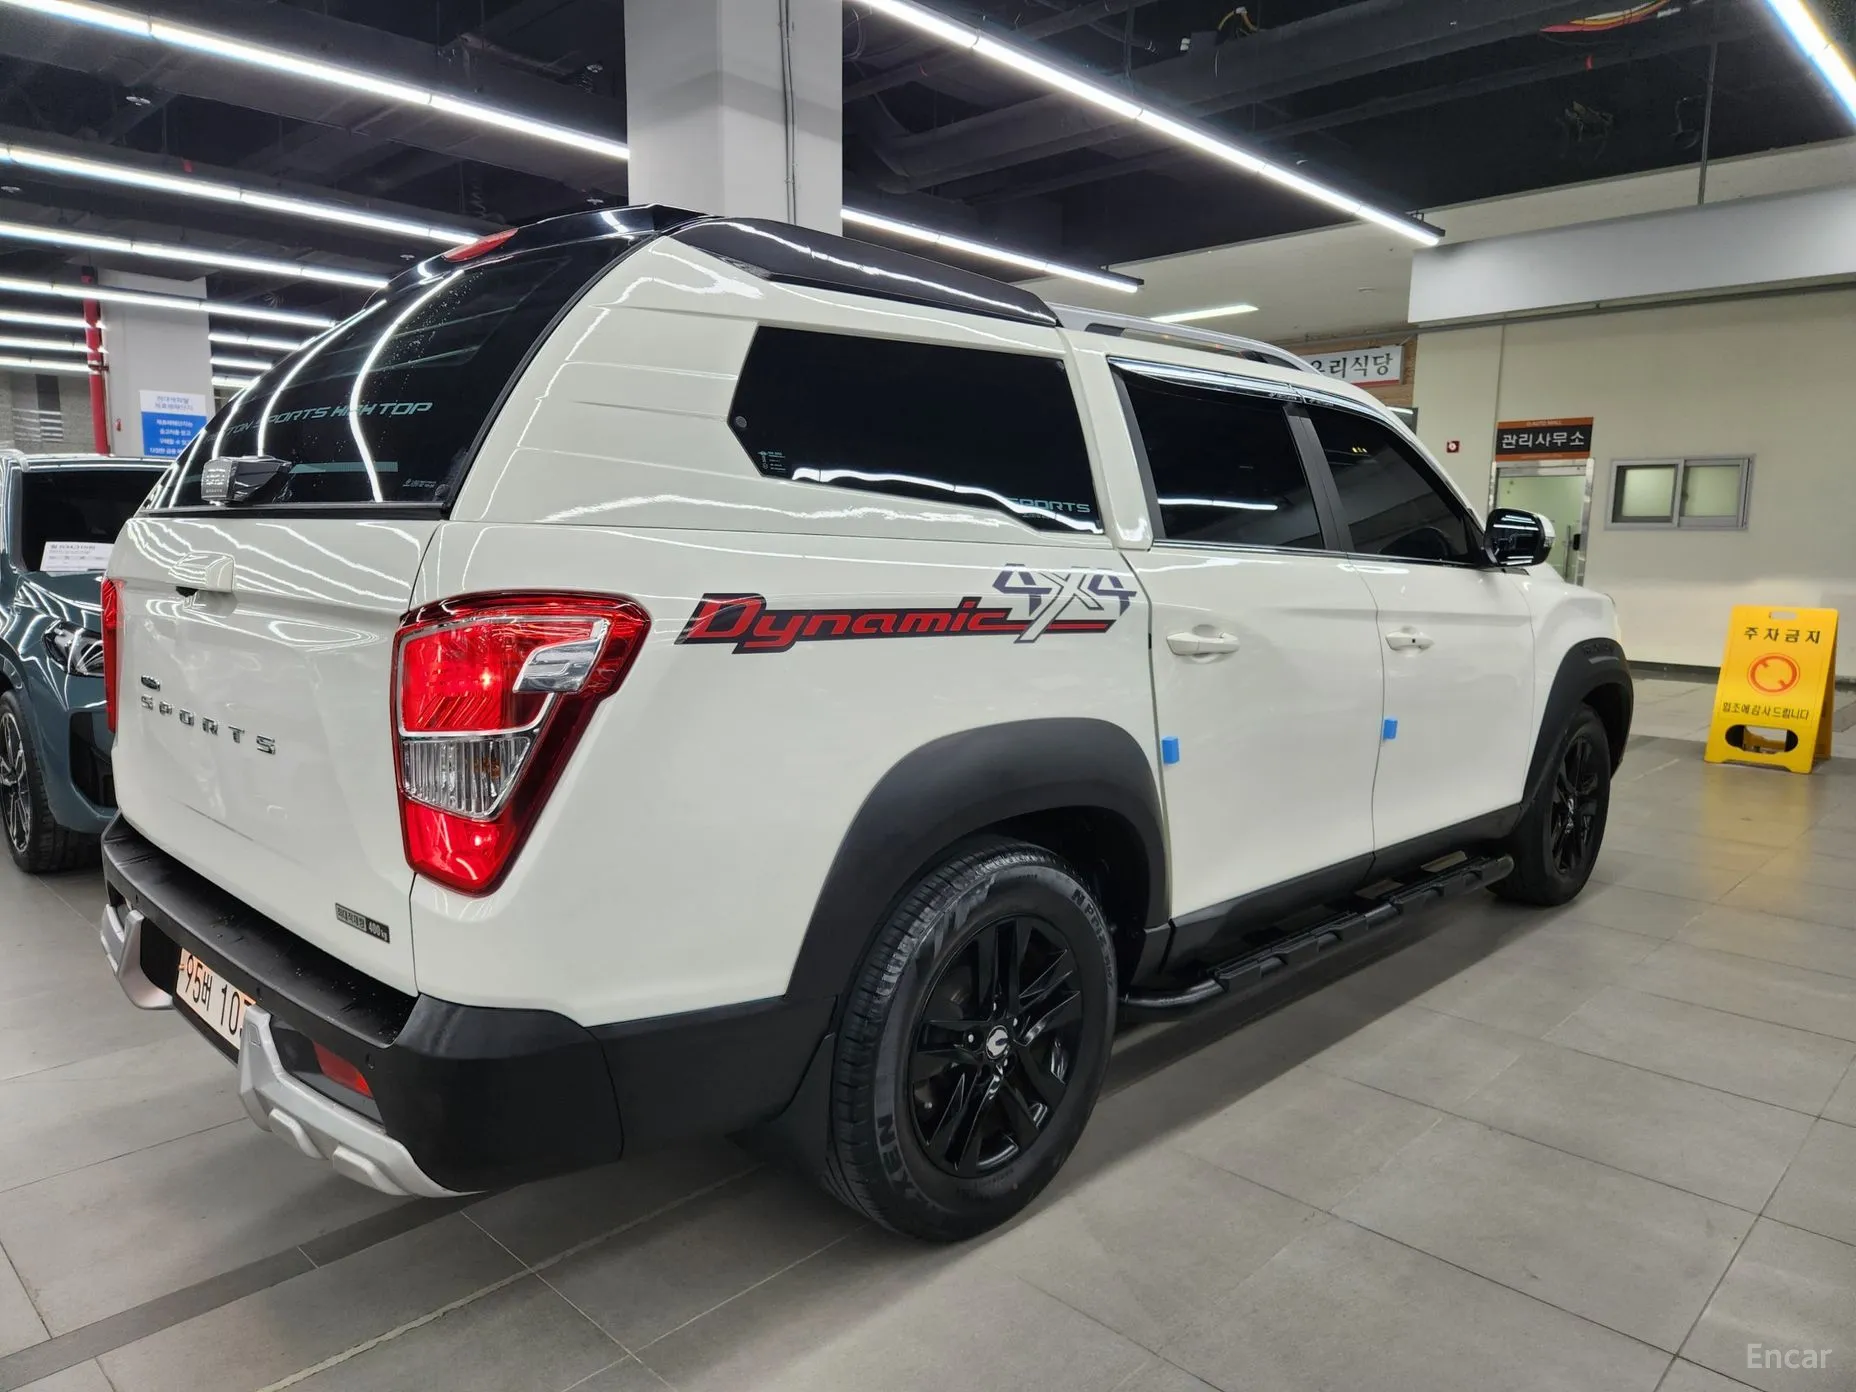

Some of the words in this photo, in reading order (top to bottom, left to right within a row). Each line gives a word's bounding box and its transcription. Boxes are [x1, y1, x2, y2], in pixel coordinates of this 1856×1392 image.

[374, 402, 434, 416] TOP
[1502, 431, 1585, 449] 관리사무소
[675, 592, 1014, 654] Dynamic
[140, 693, 277, 756] SPORTS
